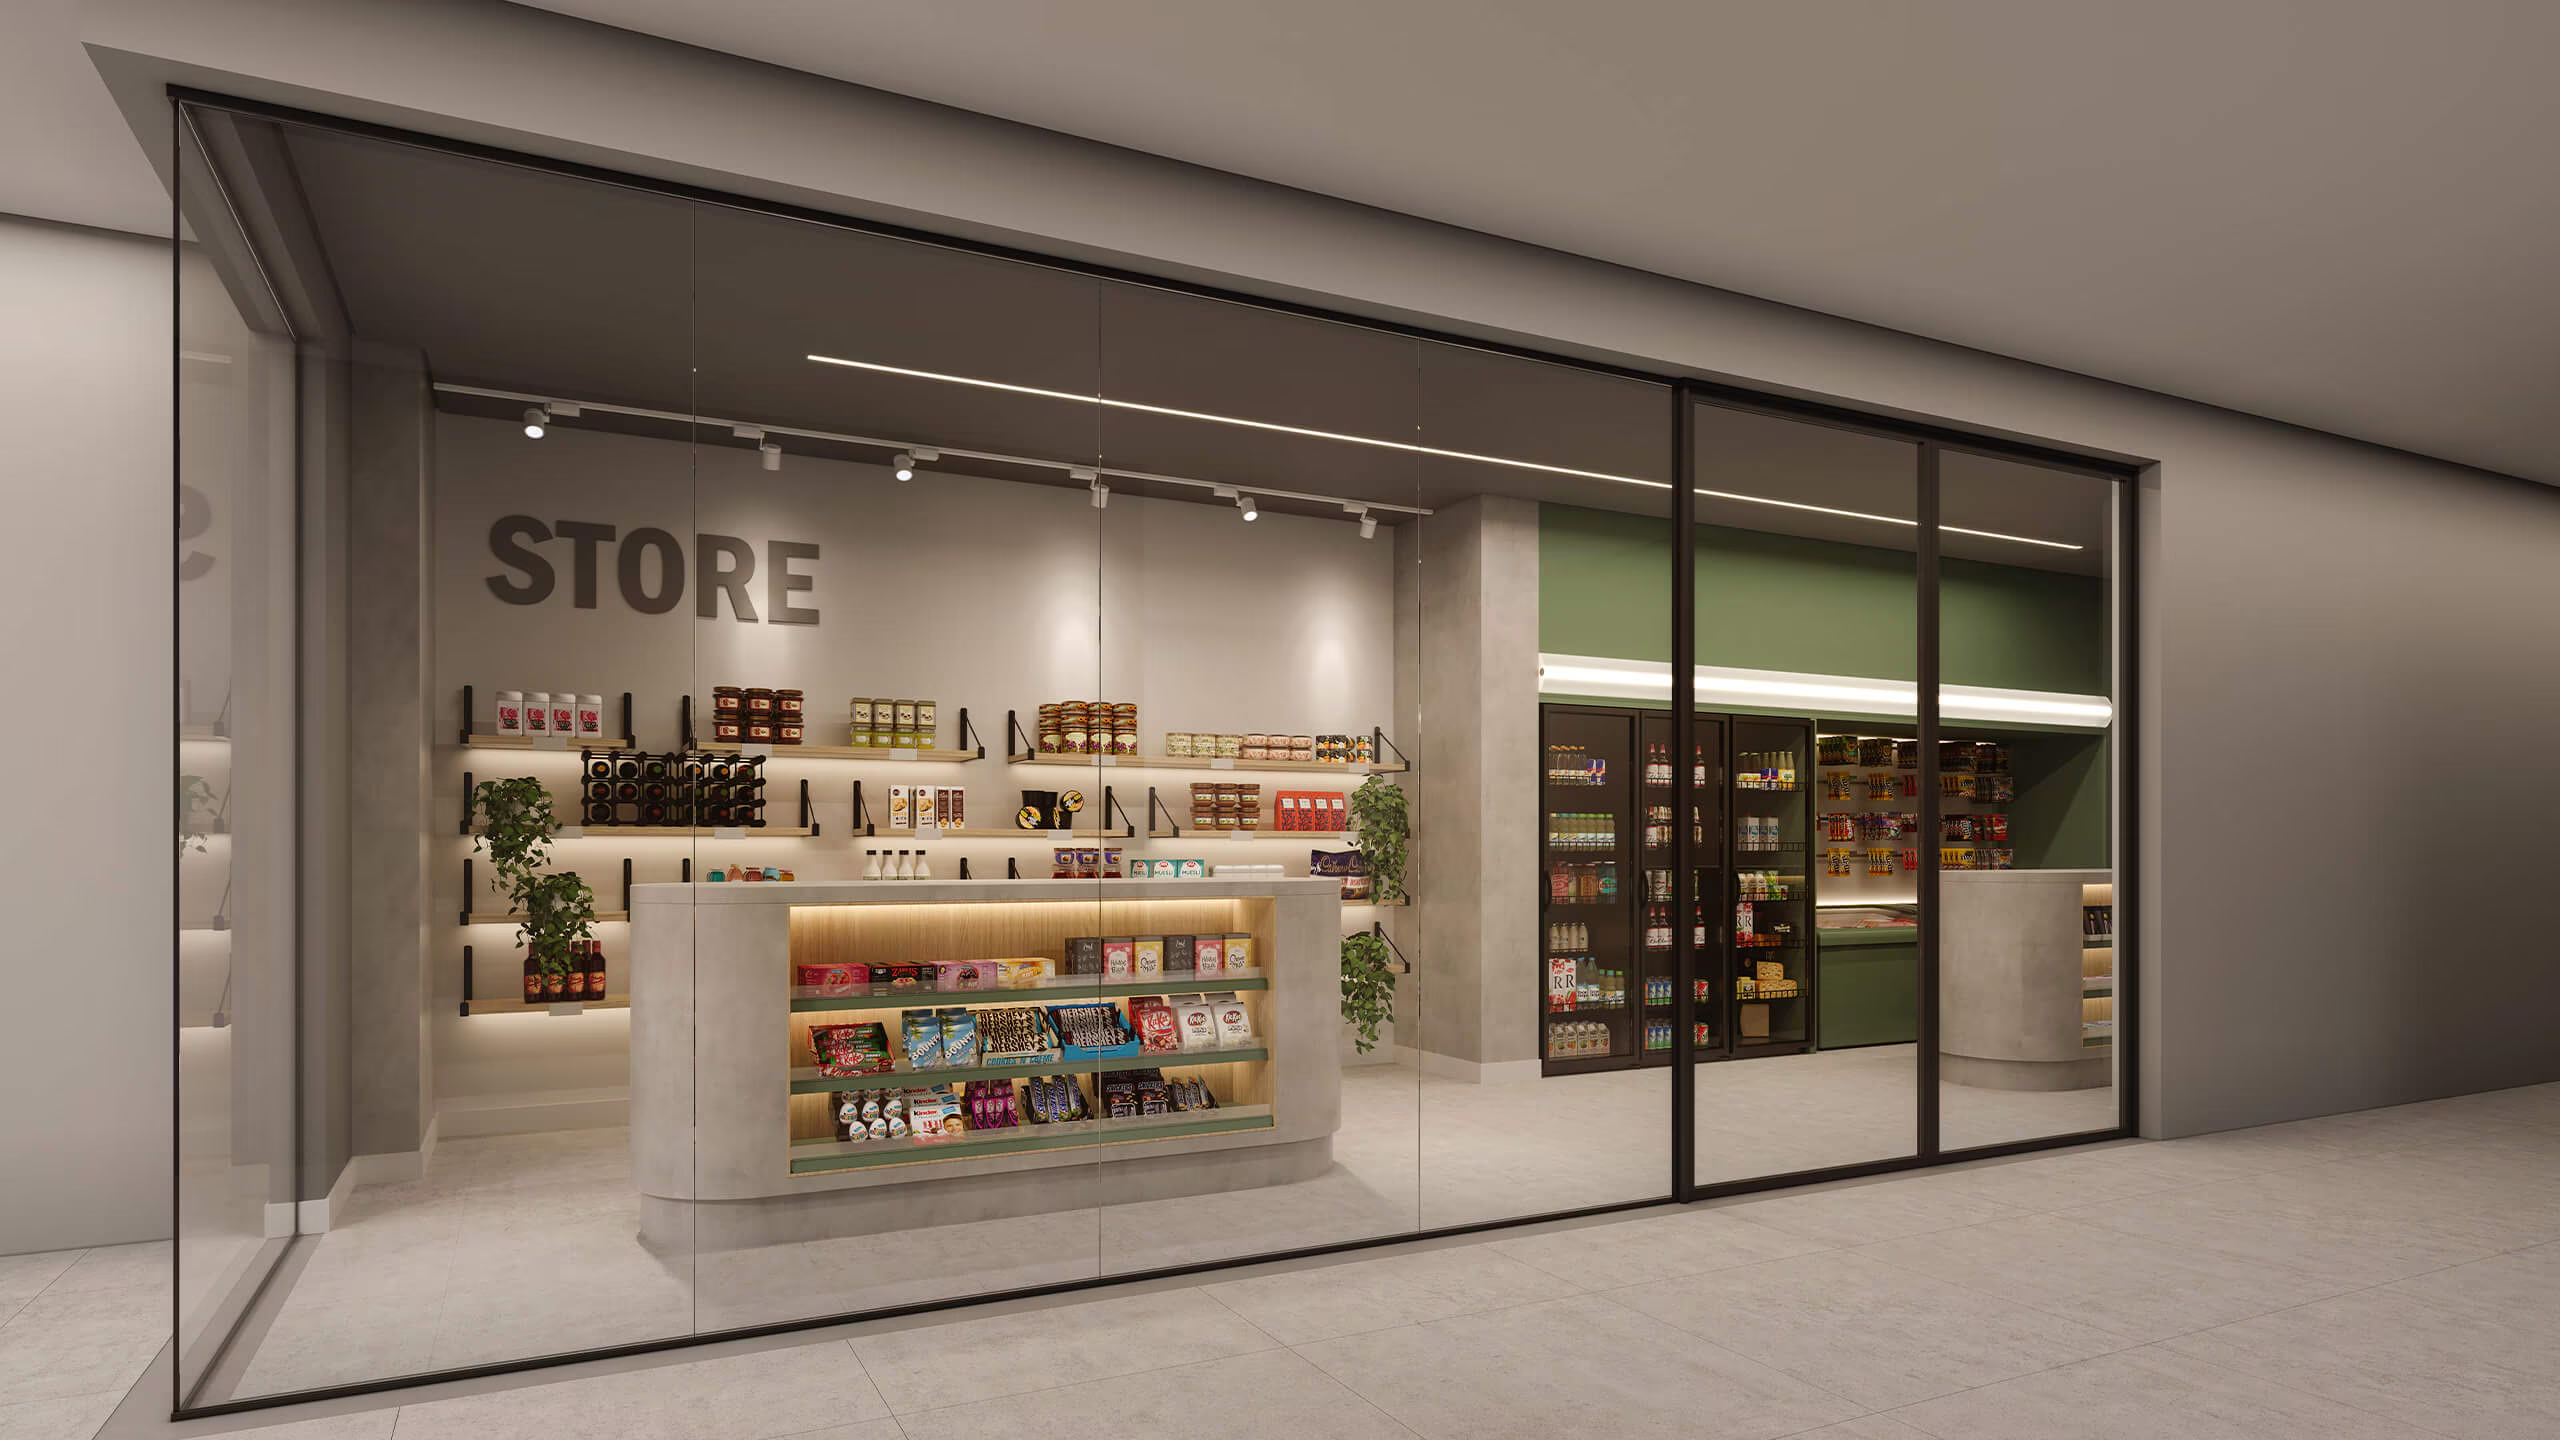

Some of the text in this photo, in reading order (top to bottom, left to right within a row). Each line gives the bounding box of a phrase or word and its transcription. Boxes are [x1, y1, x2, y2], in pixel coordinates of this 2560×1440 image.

[485, 514, 820, 626] STORE
[1554, 976, 1563, 989] R
[1566, 974, 1575, 988] R
[981, 1011, 1032, 1022] HERSHEY'S
[945, 1029, 975, 1060] BOUNTY
